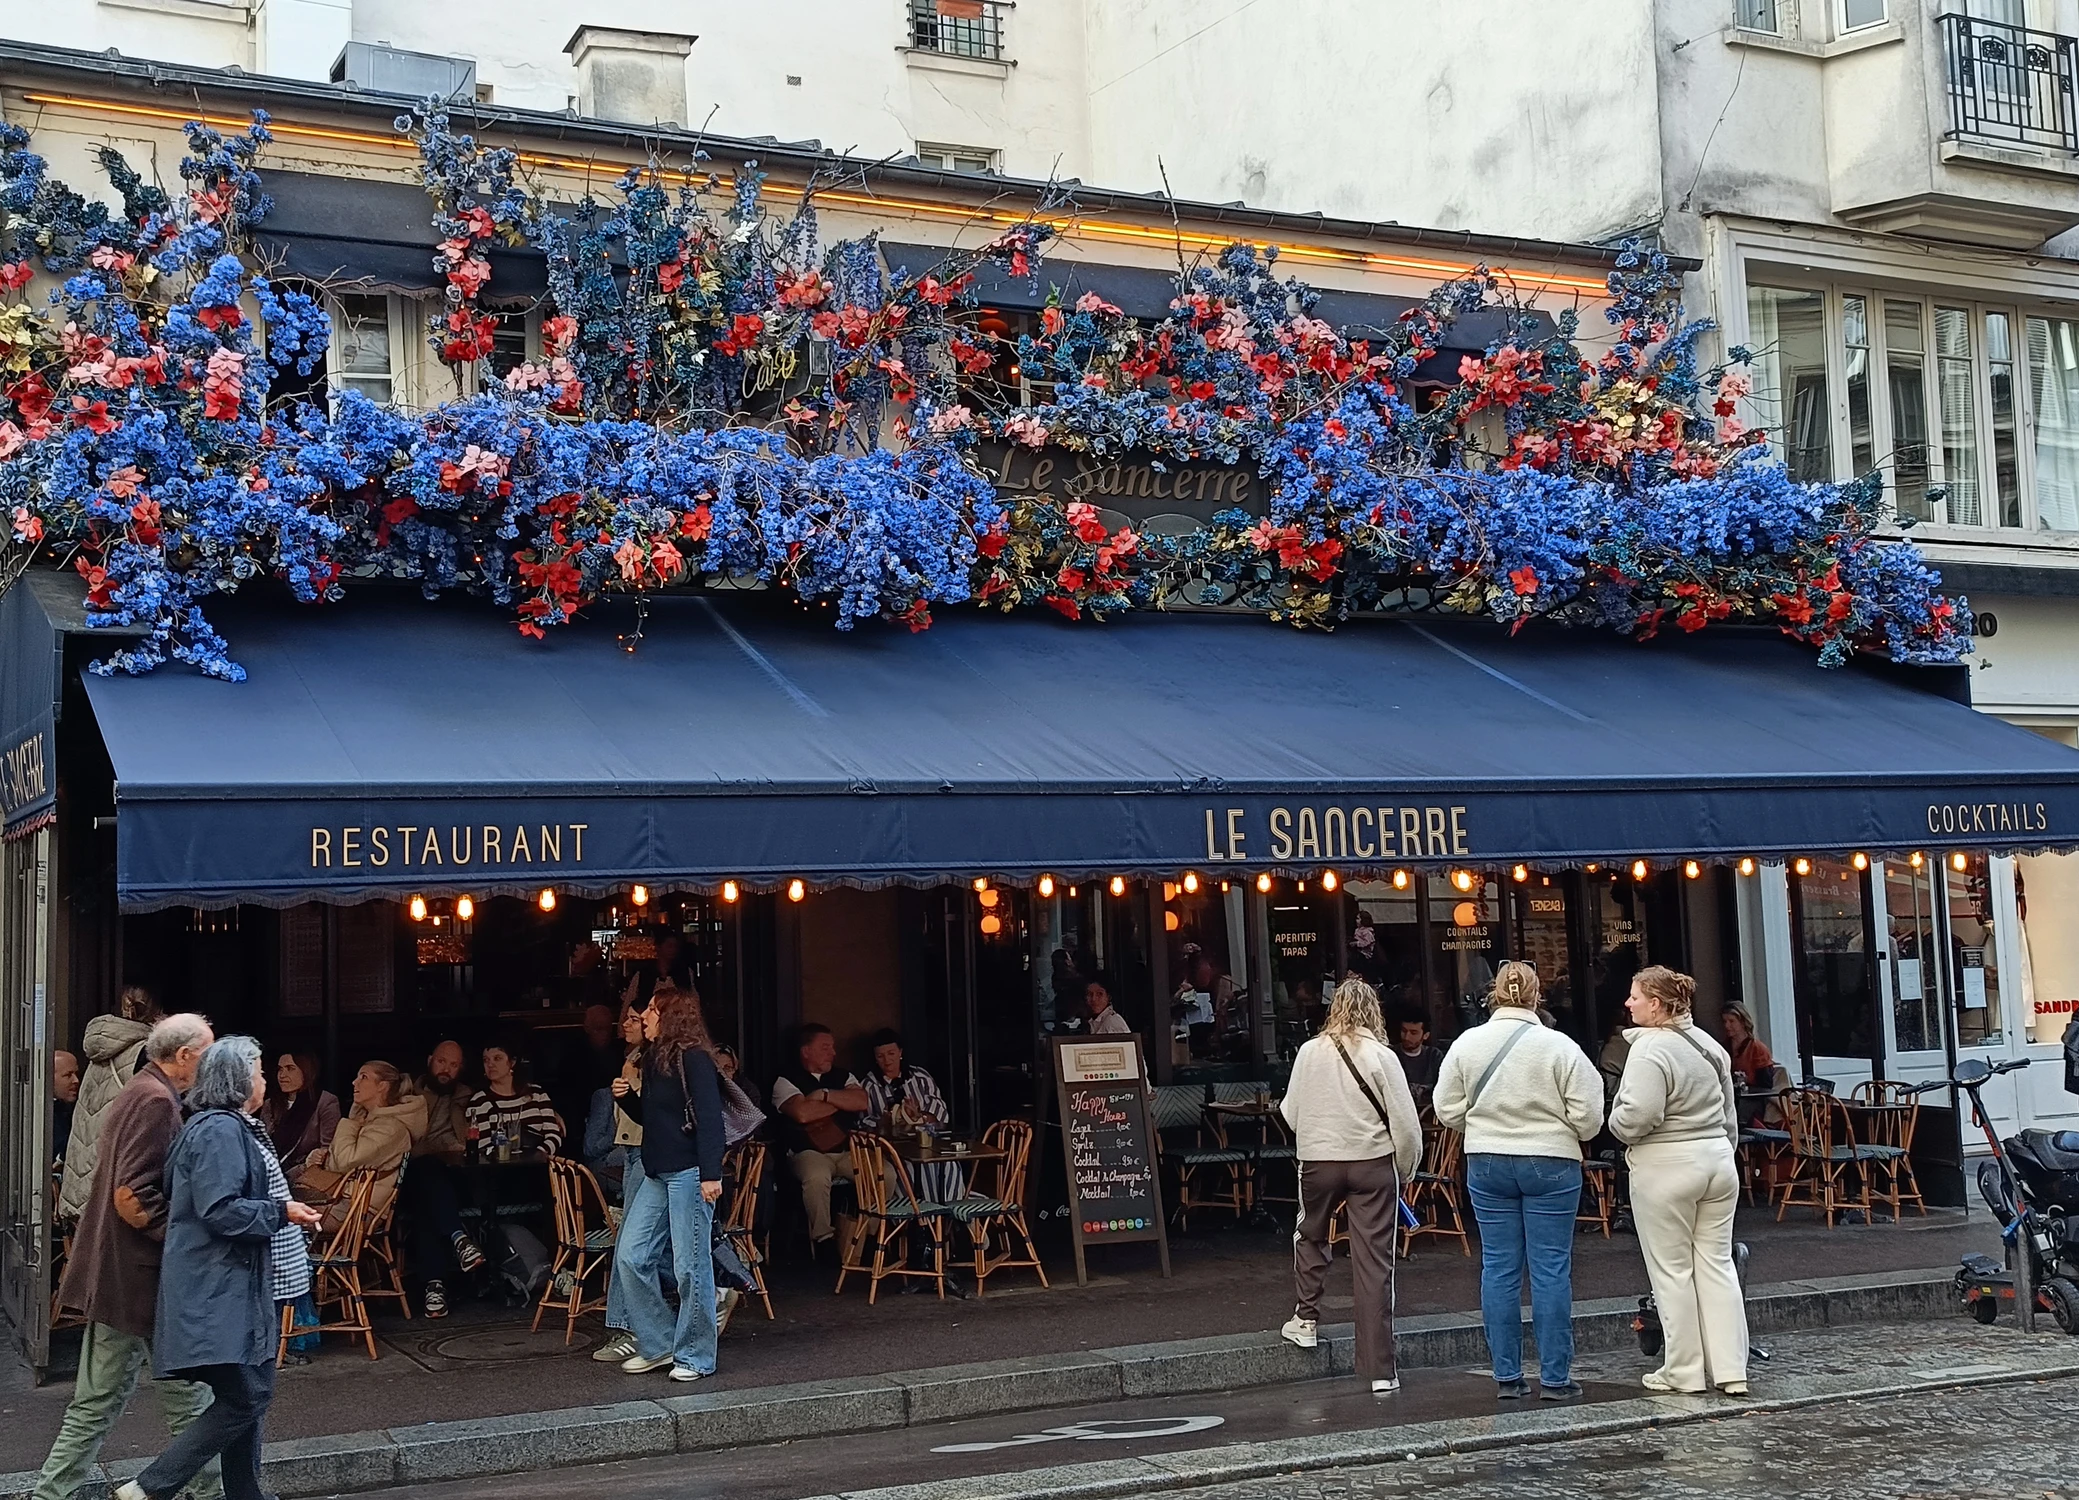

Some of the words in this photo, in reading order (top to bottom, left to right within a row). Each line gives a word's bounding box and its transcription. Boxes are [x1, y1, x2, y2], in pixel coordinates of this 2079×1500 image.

[994, 446, 1054, 490] Le
[1064, 454, 1250, 503] Sancerre
[1926, 802, 2048, 834] COCKTAILS
[1205, 808, 1247, 860] LE
[1269, 805, 1470, 860] SANCERRE
[310, 823, 589, 868] RESTAURANT
[1446, 926, 1489, 937] COCKTAILS
[1614, 921, 1633, 930] VINS
[1274, 932, 1318, 944] APERITIFS
[1606, 933, 1642, 944] LIQUEURS
[1281, 947, 1309, 957] TAPAS
[1441, 940, 1493, 951] CHAMPAGNES
[1071, 1091, 1106, 1116] Happy
[1074, 1152, 1102, 1167] Cocktail
[1076, 1170, 1100, 1184] Cocktail
